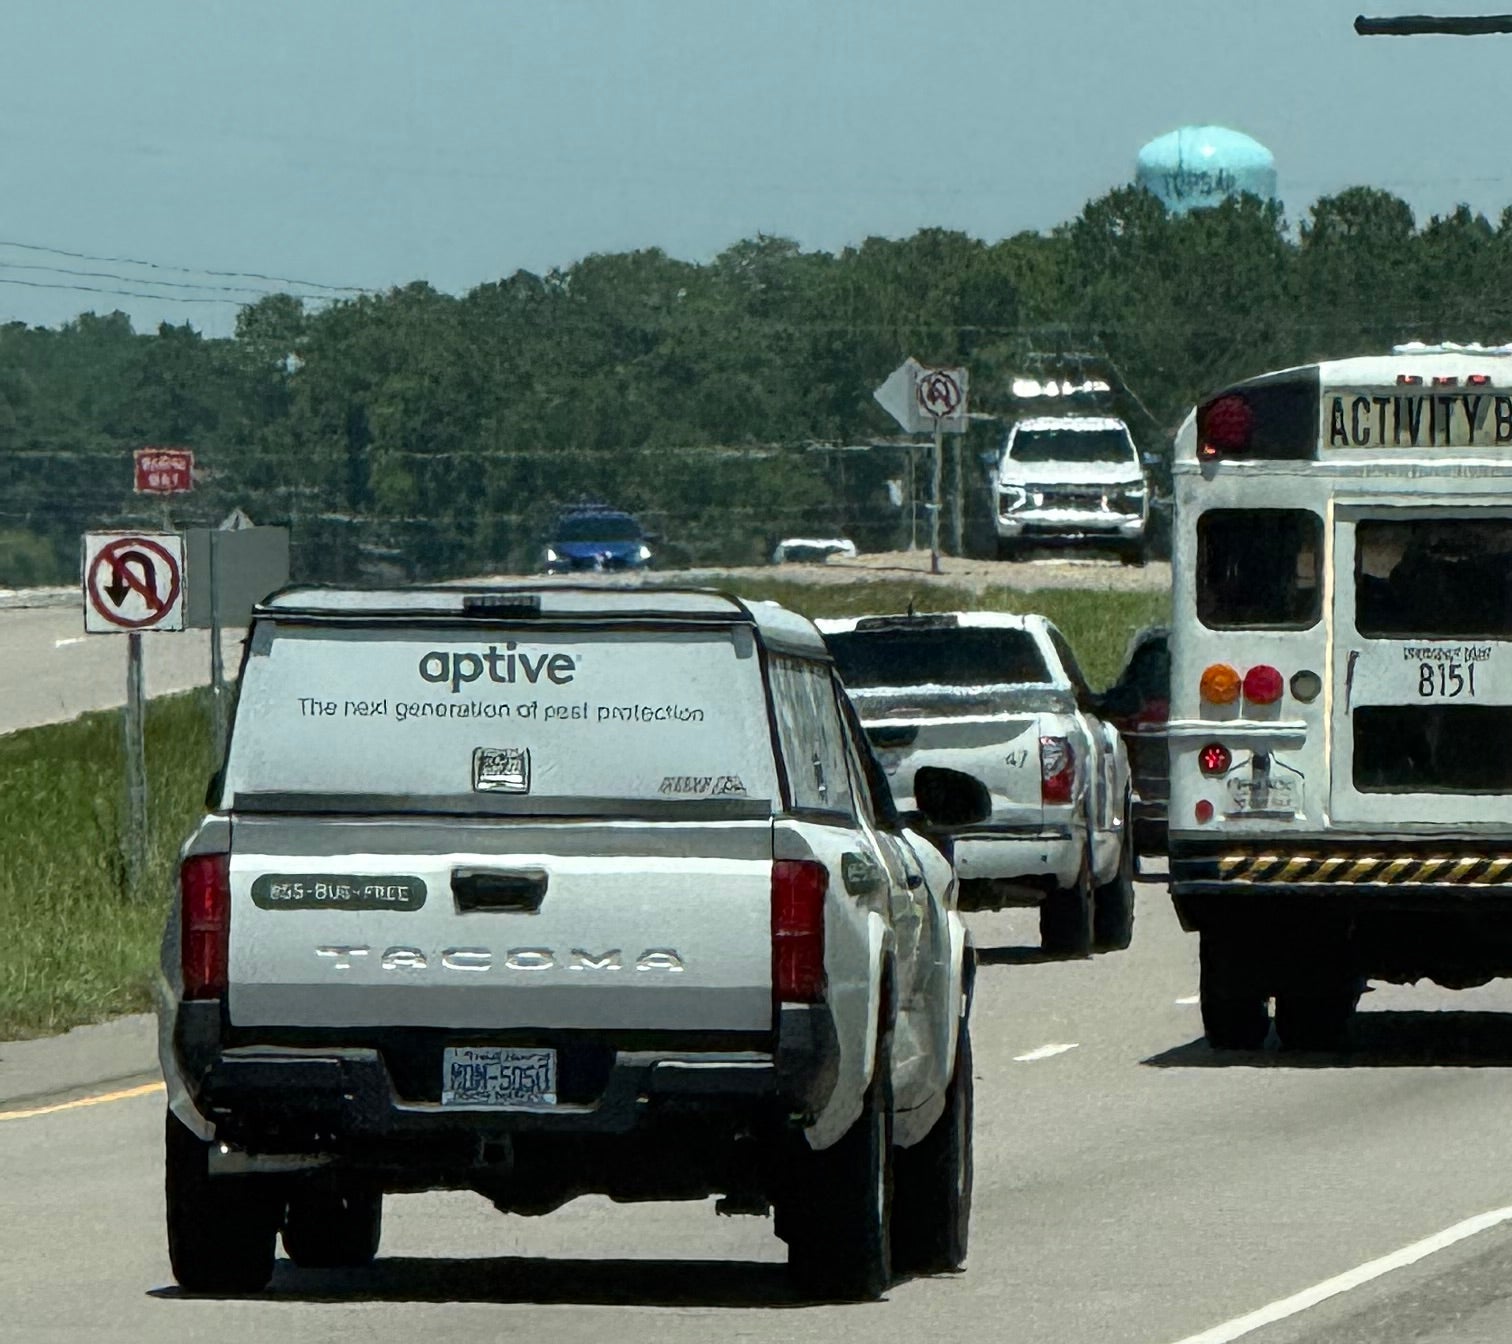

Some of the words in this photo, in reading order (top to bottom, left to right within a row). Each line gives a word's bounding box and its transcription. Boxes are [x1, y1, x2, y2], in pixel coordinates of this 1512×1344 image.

[1330, 394, 1483, 447] ACTIVITY
[419, 641, 577, 693] aptive
[1418, 662, 1475, 698] 8151
[298, 697, 338, 717] The
[344, 699, 388, 717] next
[395, 699, 511, 722] generation
[516, 700, 538, 720] of
[544, 702, 588, 722] pest
[597, 704, 704, 723] protection
[315, 944, 685, 972] TACOMA
